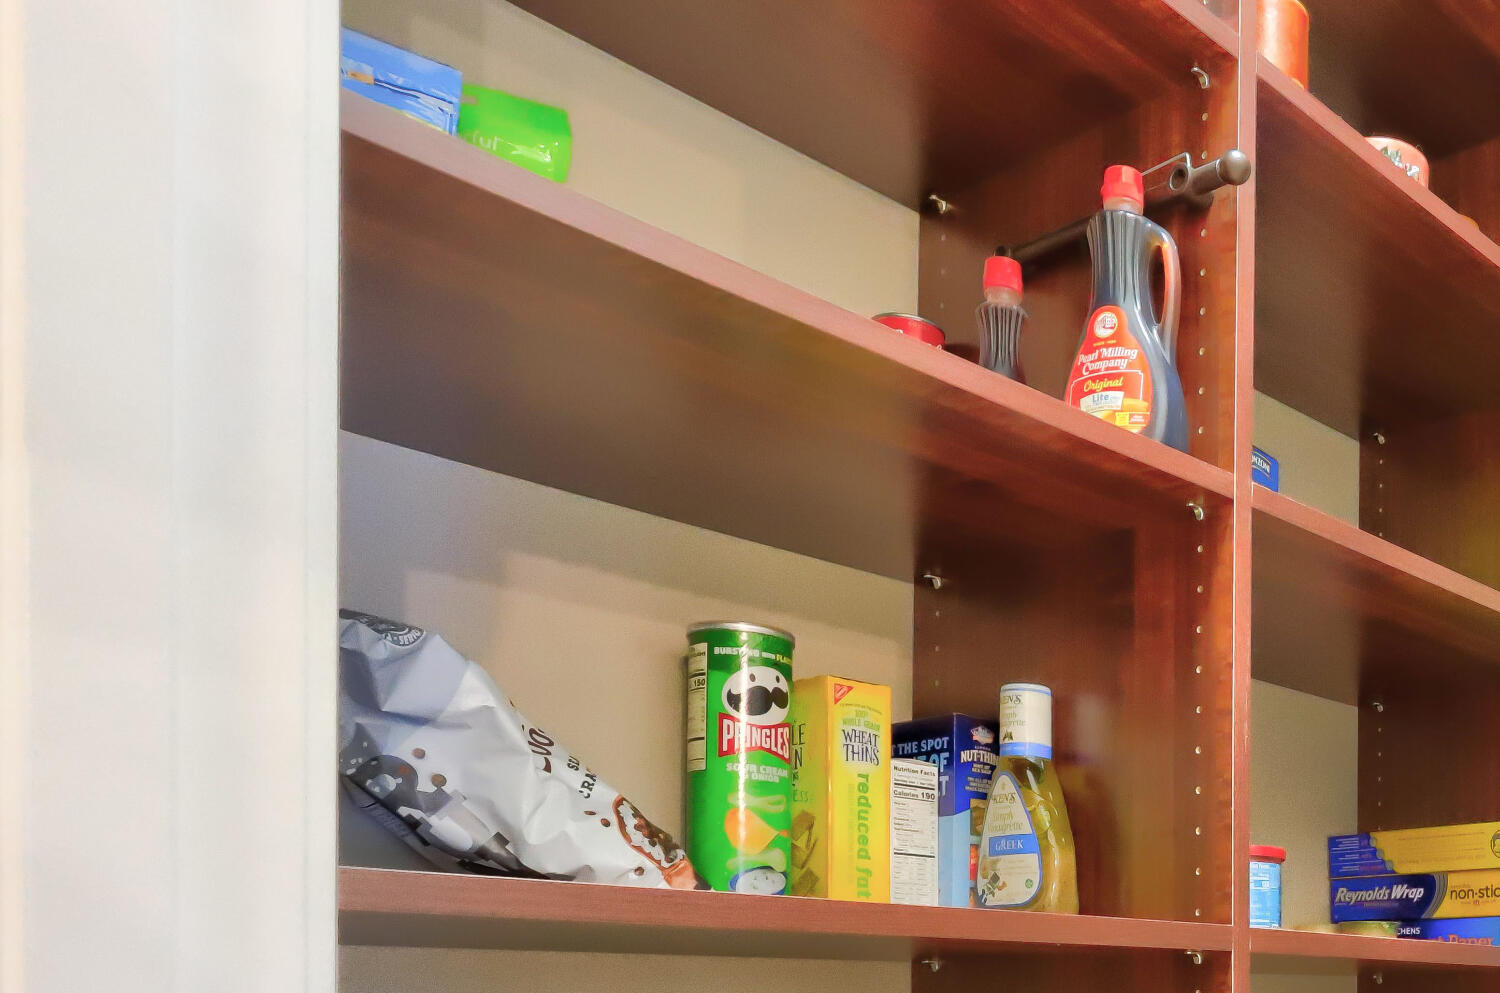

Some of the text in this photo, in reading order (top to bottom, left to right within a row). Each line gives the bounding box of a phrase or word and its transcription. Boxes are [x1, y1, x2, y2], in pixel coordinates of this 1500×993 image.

[1078, 347, 1138, 366] Pearl Milling
[1082, 358, 1129, 375] Company
[1083, 376, 1124, 392] Original
[1092, 393, 1109, 403] Lite
[693, 679, 706, 688] 150
[842, 729, 879, 746] WHEAT
[899, 736, 950, 755] THE SPOT
[843, 743, 879, 766] THINS
[726, 763, 757, 772] SOR
[893, 765, 936, 777] Nutrition Facts
[893, 789, 936, 801] Calories 190
[856, 773, 872, 899] reduced fat
[995, 839, 1024, 851] GREEK
[1335, 884, 1424, 905] Reynolds Wrap
